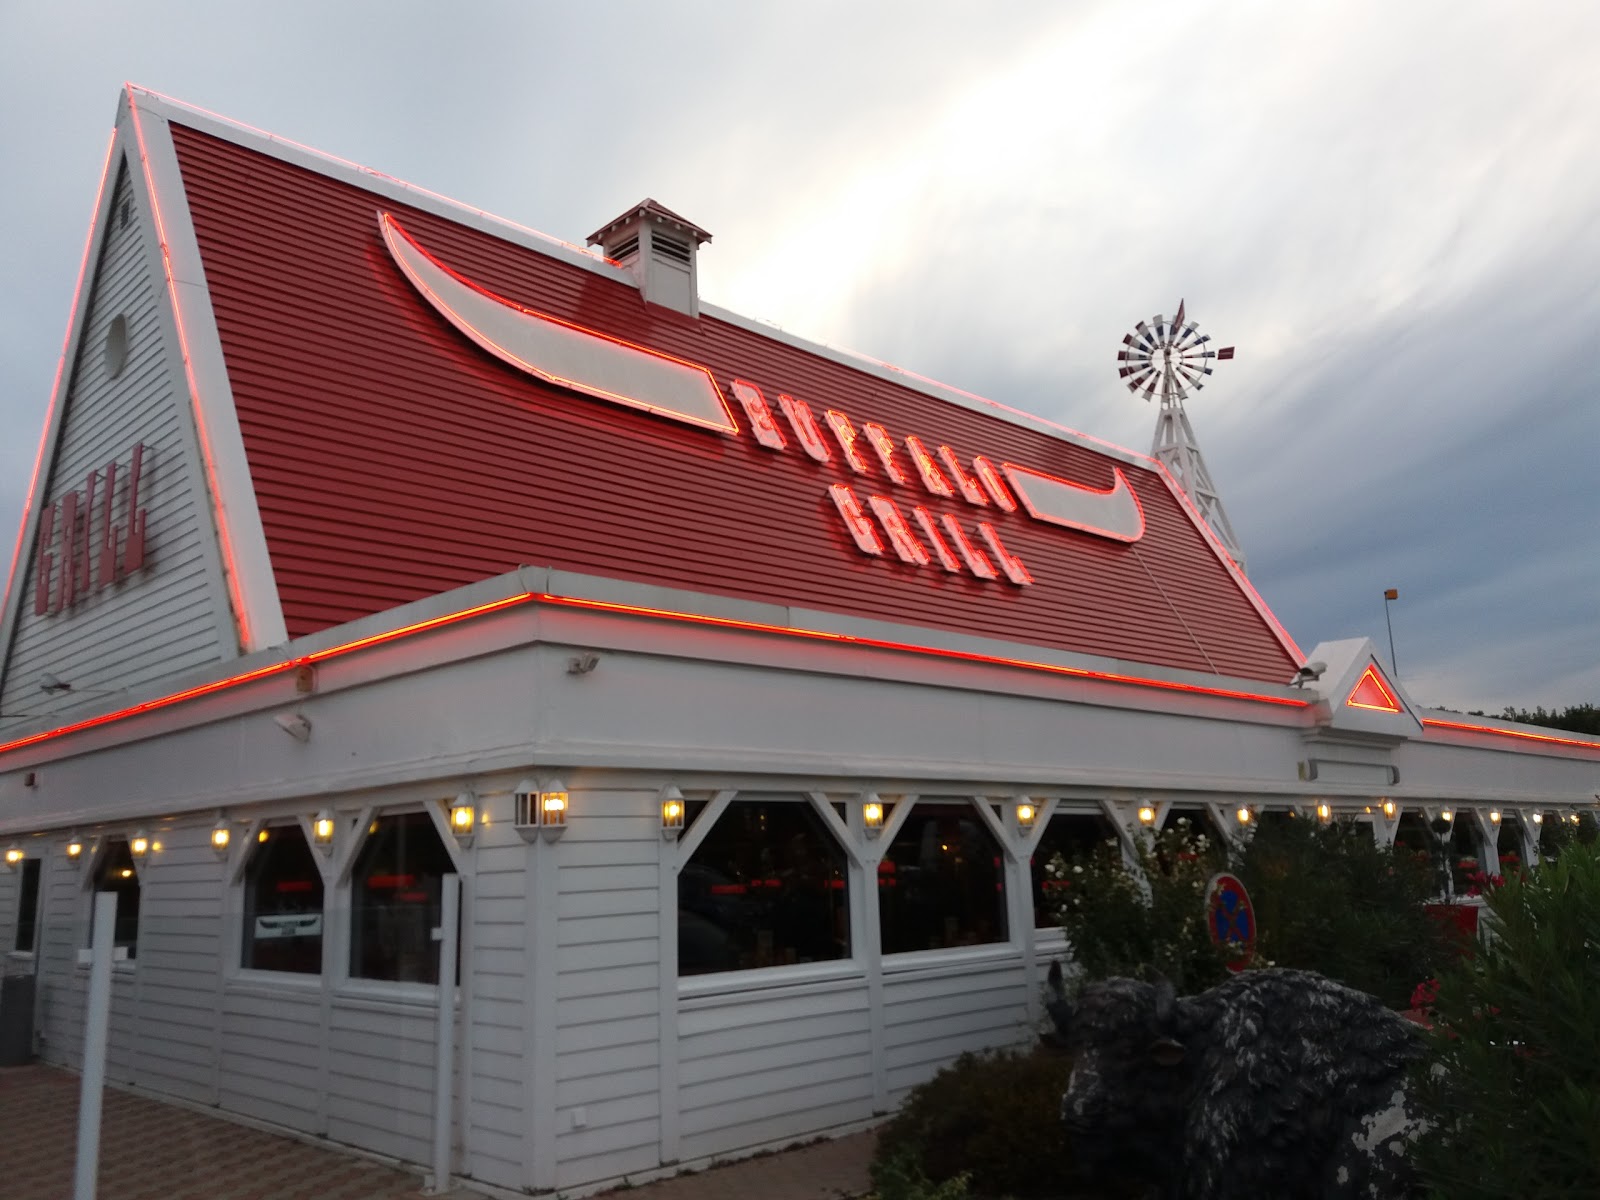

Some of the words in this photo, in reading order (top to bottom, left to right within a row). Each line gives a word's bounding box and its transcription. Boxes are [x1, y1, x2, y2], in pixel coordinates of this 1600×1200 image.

[731, 379, 1017, 512] BUFFALO
[35, 442, 146, 617] GRILL
[829, 483, 1035, 586] GRILL
